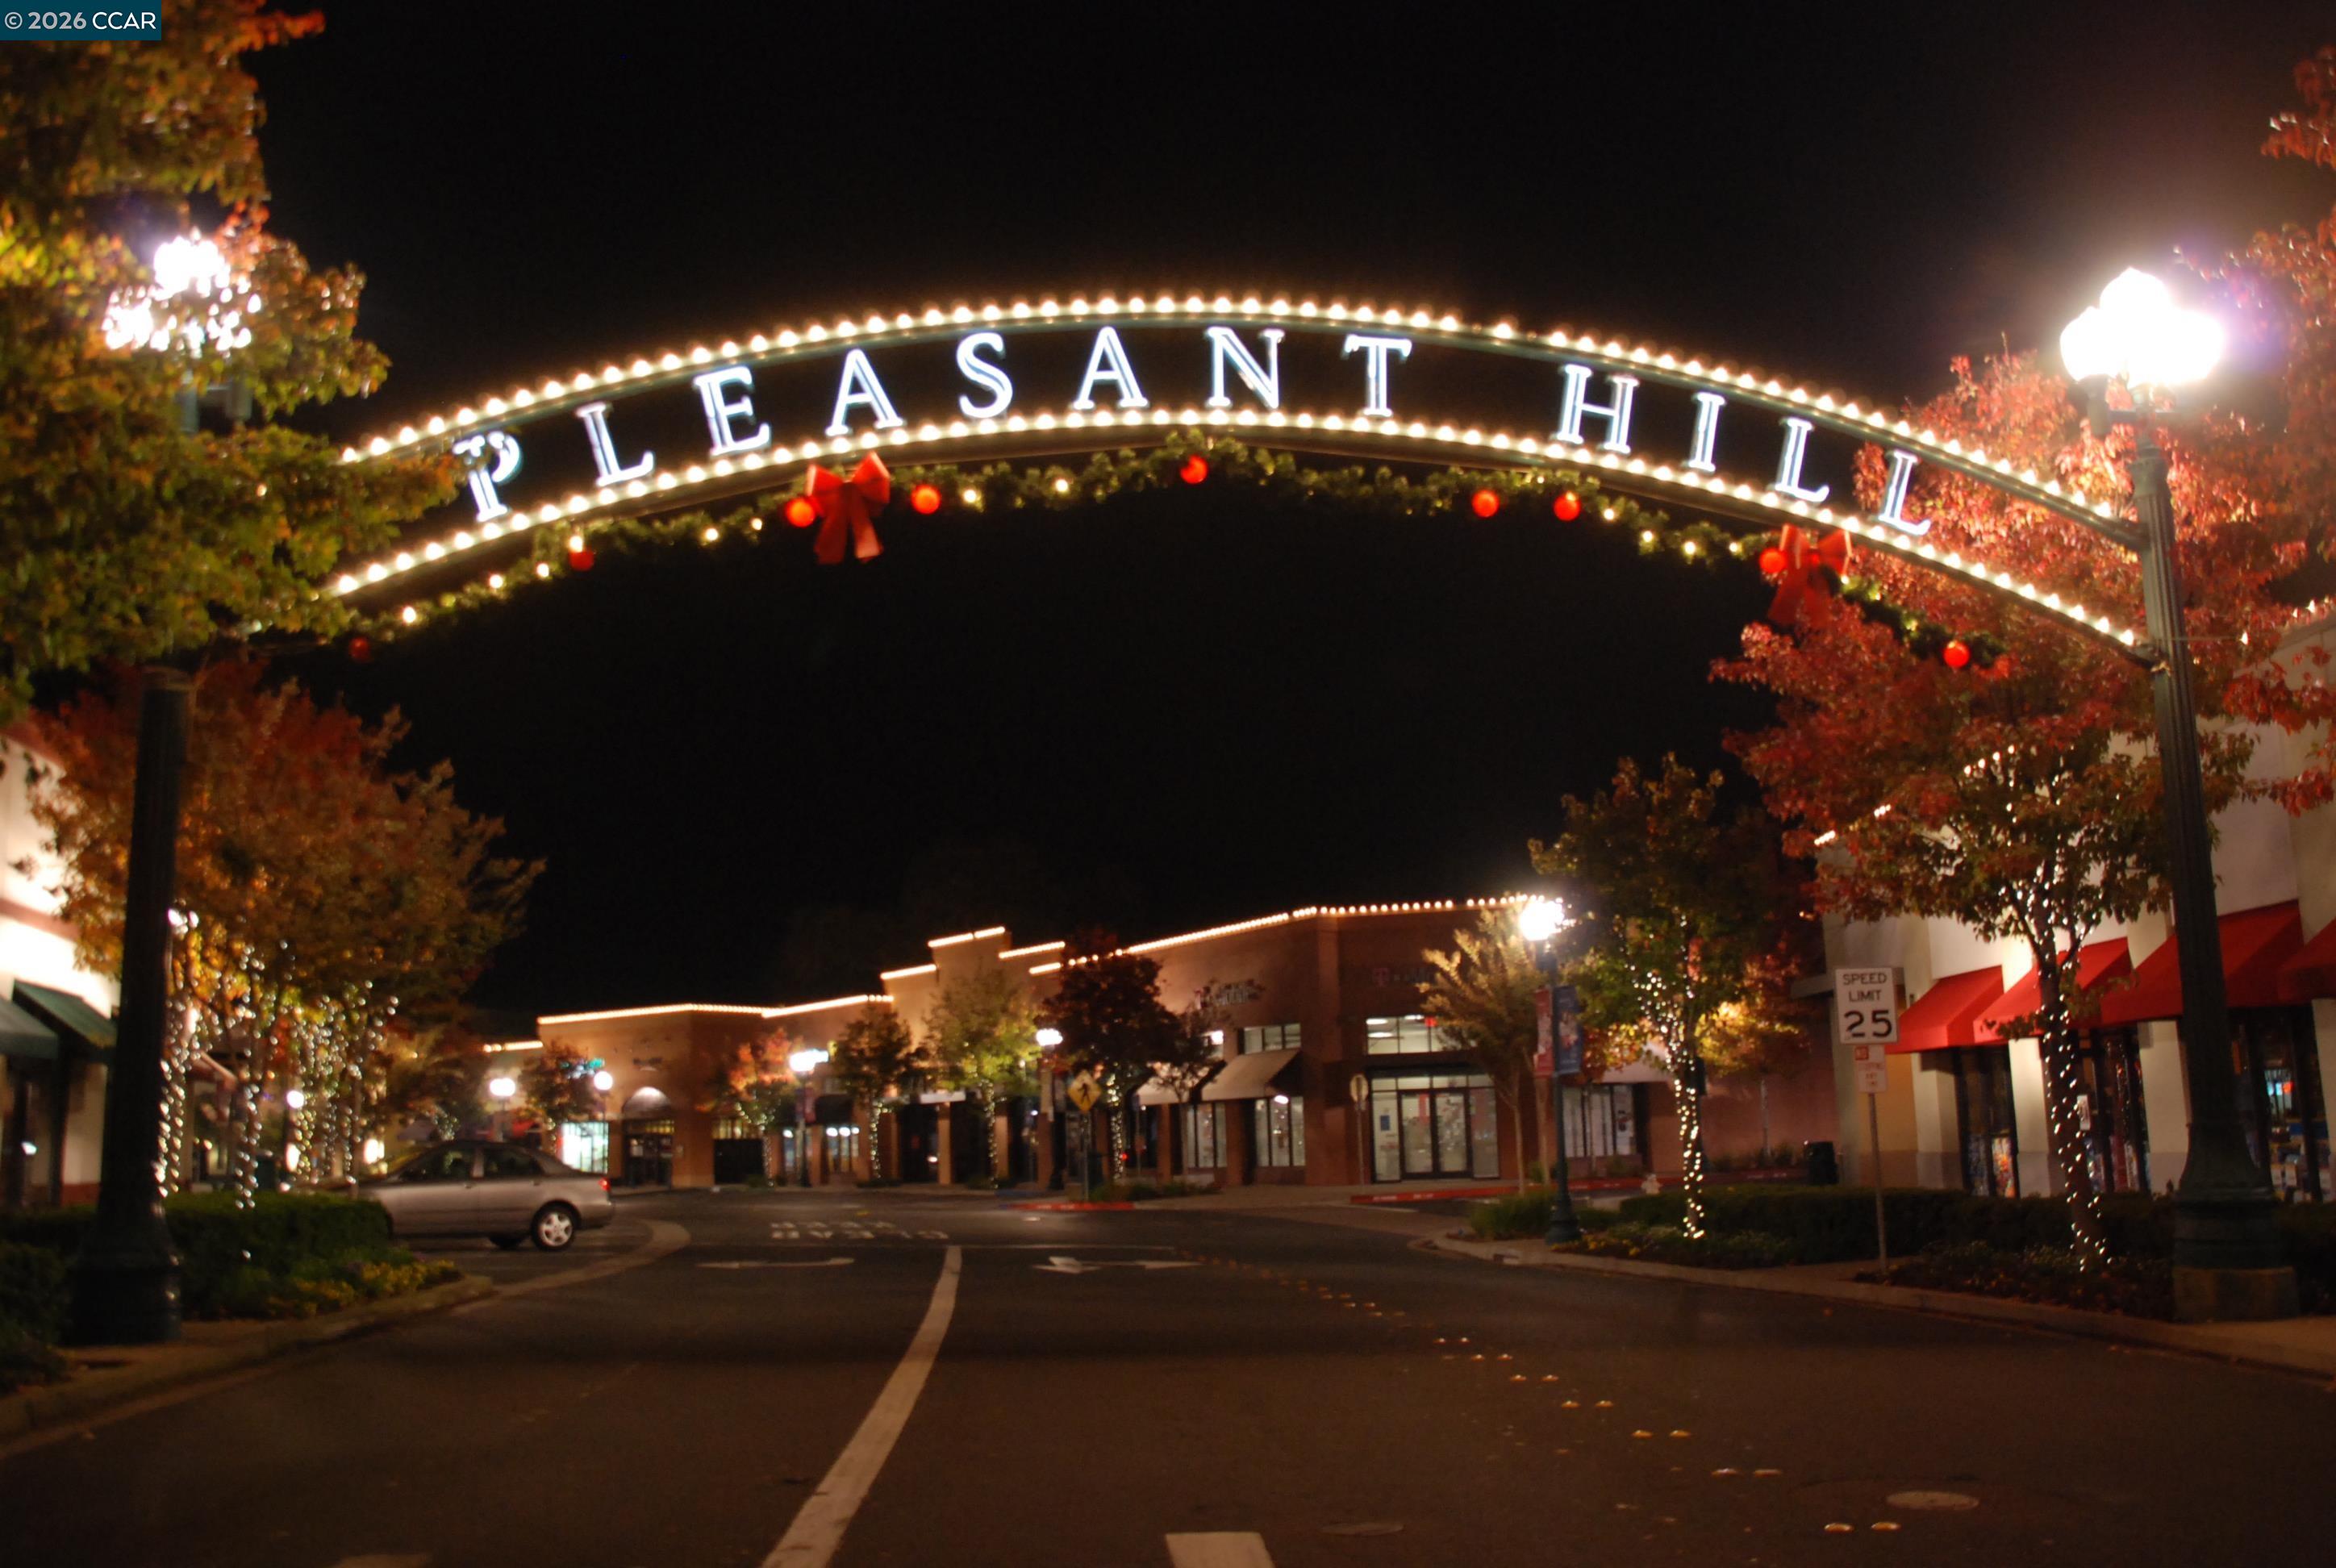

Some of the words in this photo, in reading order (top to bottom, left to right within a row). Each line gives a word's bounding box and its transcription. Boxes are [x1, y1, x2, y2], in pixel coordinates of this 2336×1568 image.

[453, 326, 1413, 522] PLEASANT
[1555, 363, 1931, 536] HILL
[1842, 973, 1888, 986] SPEED
[1848, 990, 1883, 1003] LIMIT
[1844, 1010, 1892, 1038] 25
